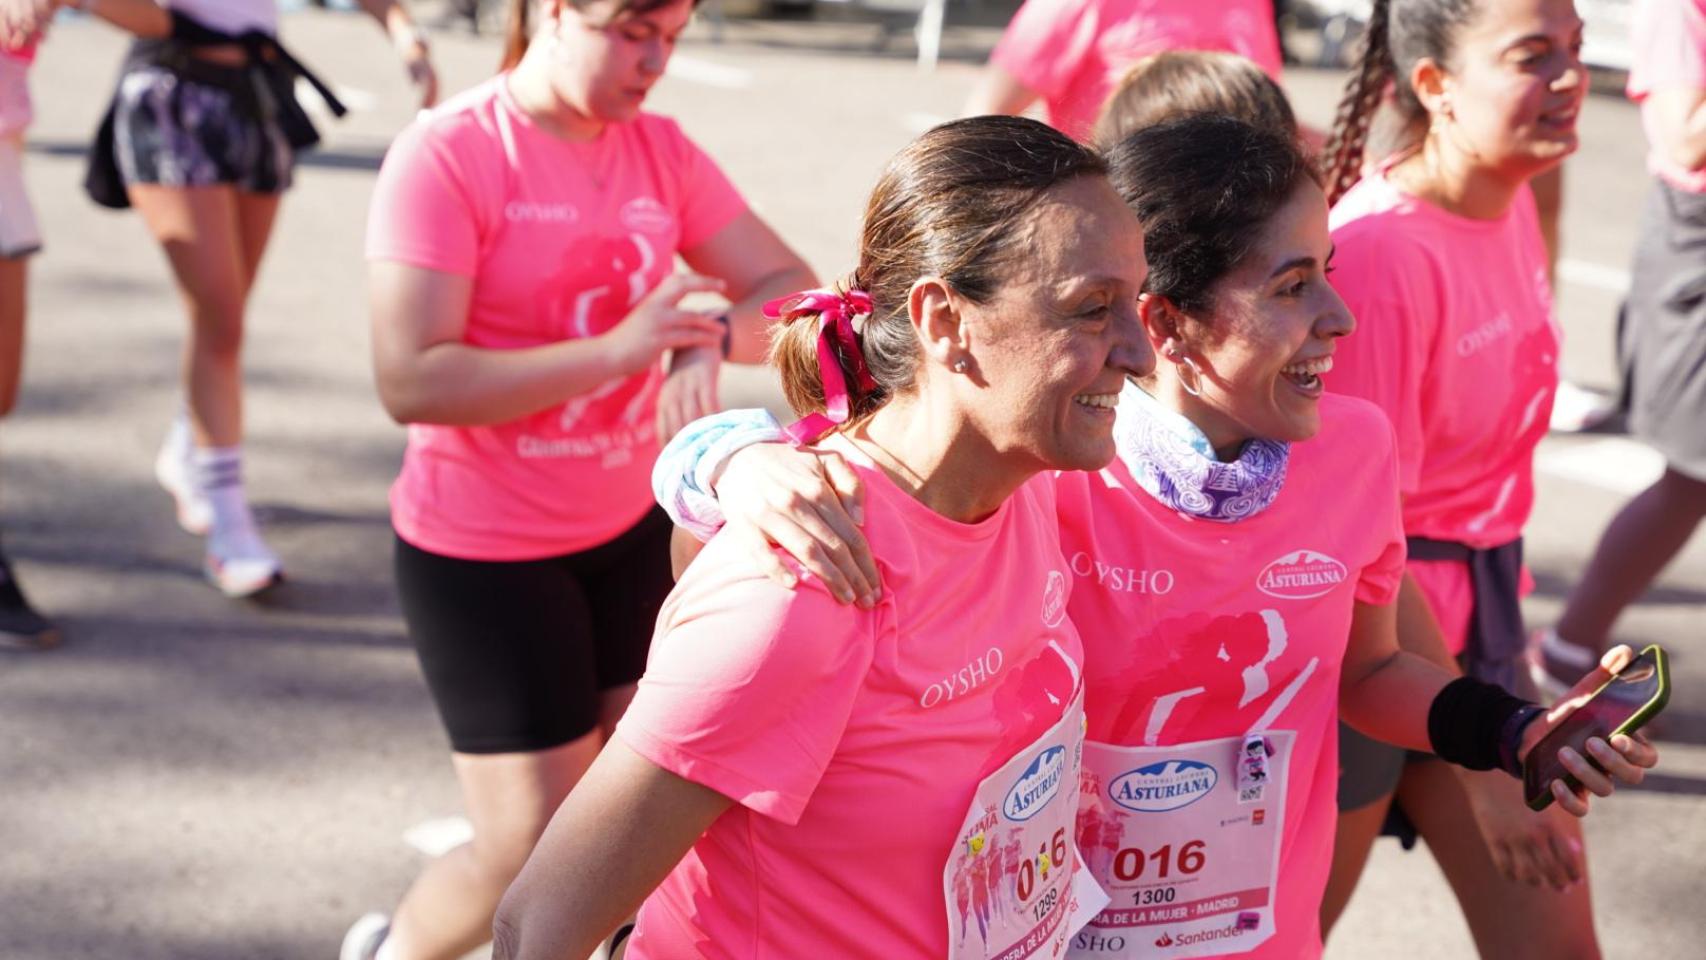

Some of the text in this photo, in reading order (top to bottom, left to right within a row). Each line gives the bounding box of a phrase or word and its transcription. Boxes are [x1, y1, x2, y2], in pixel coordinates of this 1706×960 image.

[1071, 551, 1175, 595] OYSHO
[1263, 570, 1342, 588] ASTURIANA
[920, 647, 1003, 709] OYSHO
[1118, 777, 1210, 801] ASTURIANA
[1113, 840, 1206, 882] 016
[1132, 887, 1176, 906] 1300
[1113, 913, 1130, 924] DE
[1131, 911, 1147, 923] LA
[1150, 905, 1189, 921] MUJER
[1196, 896, 1240, 915] MADRID
[1175, 924, 1244, 947] Santander
